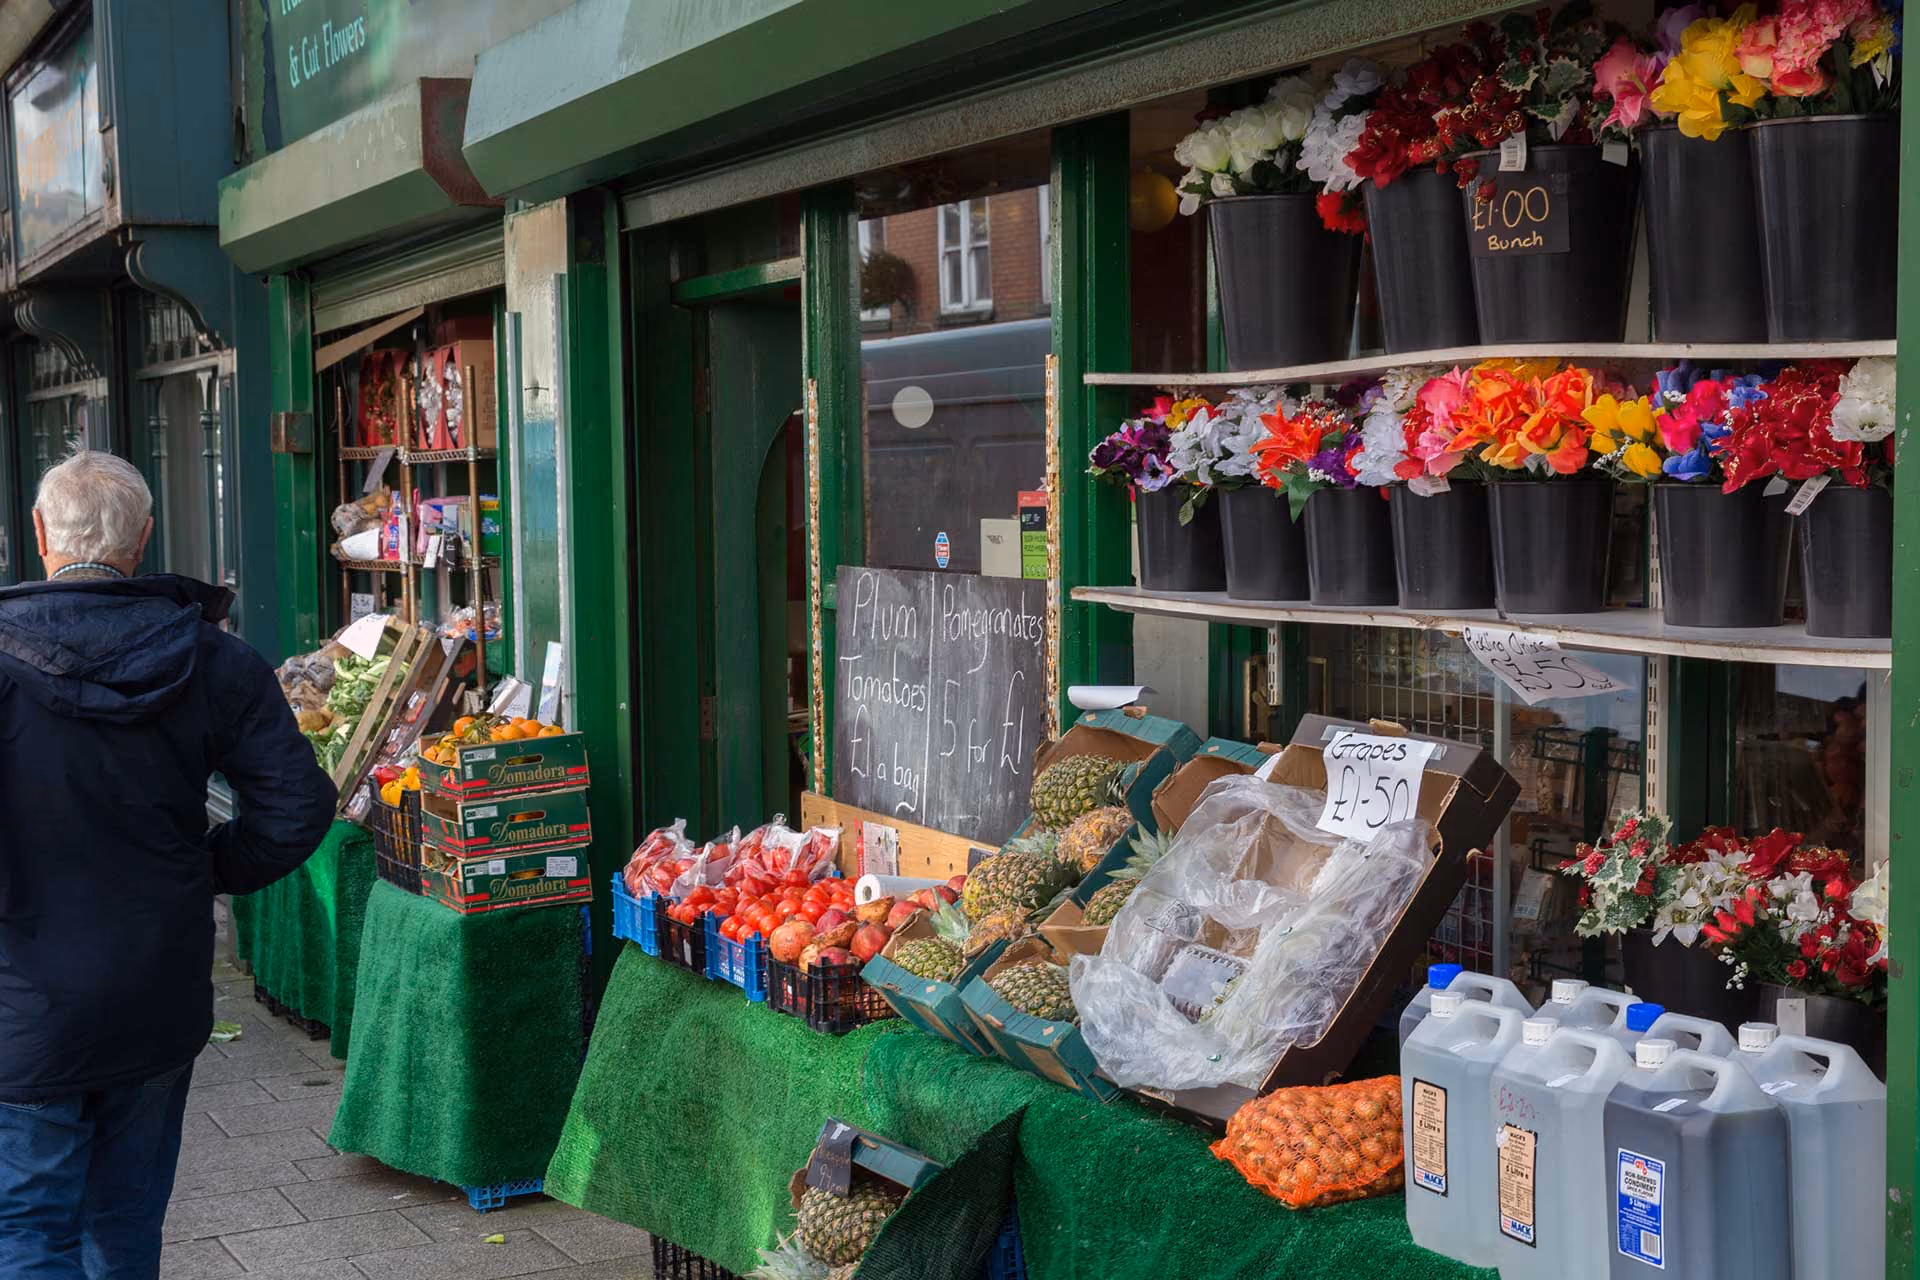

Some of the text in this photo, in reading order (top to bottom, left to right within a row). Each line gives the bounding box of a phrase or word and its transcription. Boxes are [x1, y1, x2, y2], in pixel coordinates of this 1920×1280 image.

[289, 16, 366, 88] & Cut Flowers
[1487, 231, 1543, 250] Bunch
[853, 572, 917, 641] Plum
[943, 584, 1044, 674] Pomegranates
[839, 648, 926, 712] Tomatoes
[940, 670, 1025, 775] 5 for £1
[851, 704, 920, 813] £1 a bag
[1331, 733, 1408, 777] Grapes
[488, 763, 566, 786] Domadora
[489, 821, 568, 843] Domadora
[489, 878, 567, 900] Domadora
[1424, 1171, 1444, 1187] MACK
[1624, 1177, 1657, 1193] CONDIMENT
[1511, 1220, 1532, 1237] MACK
